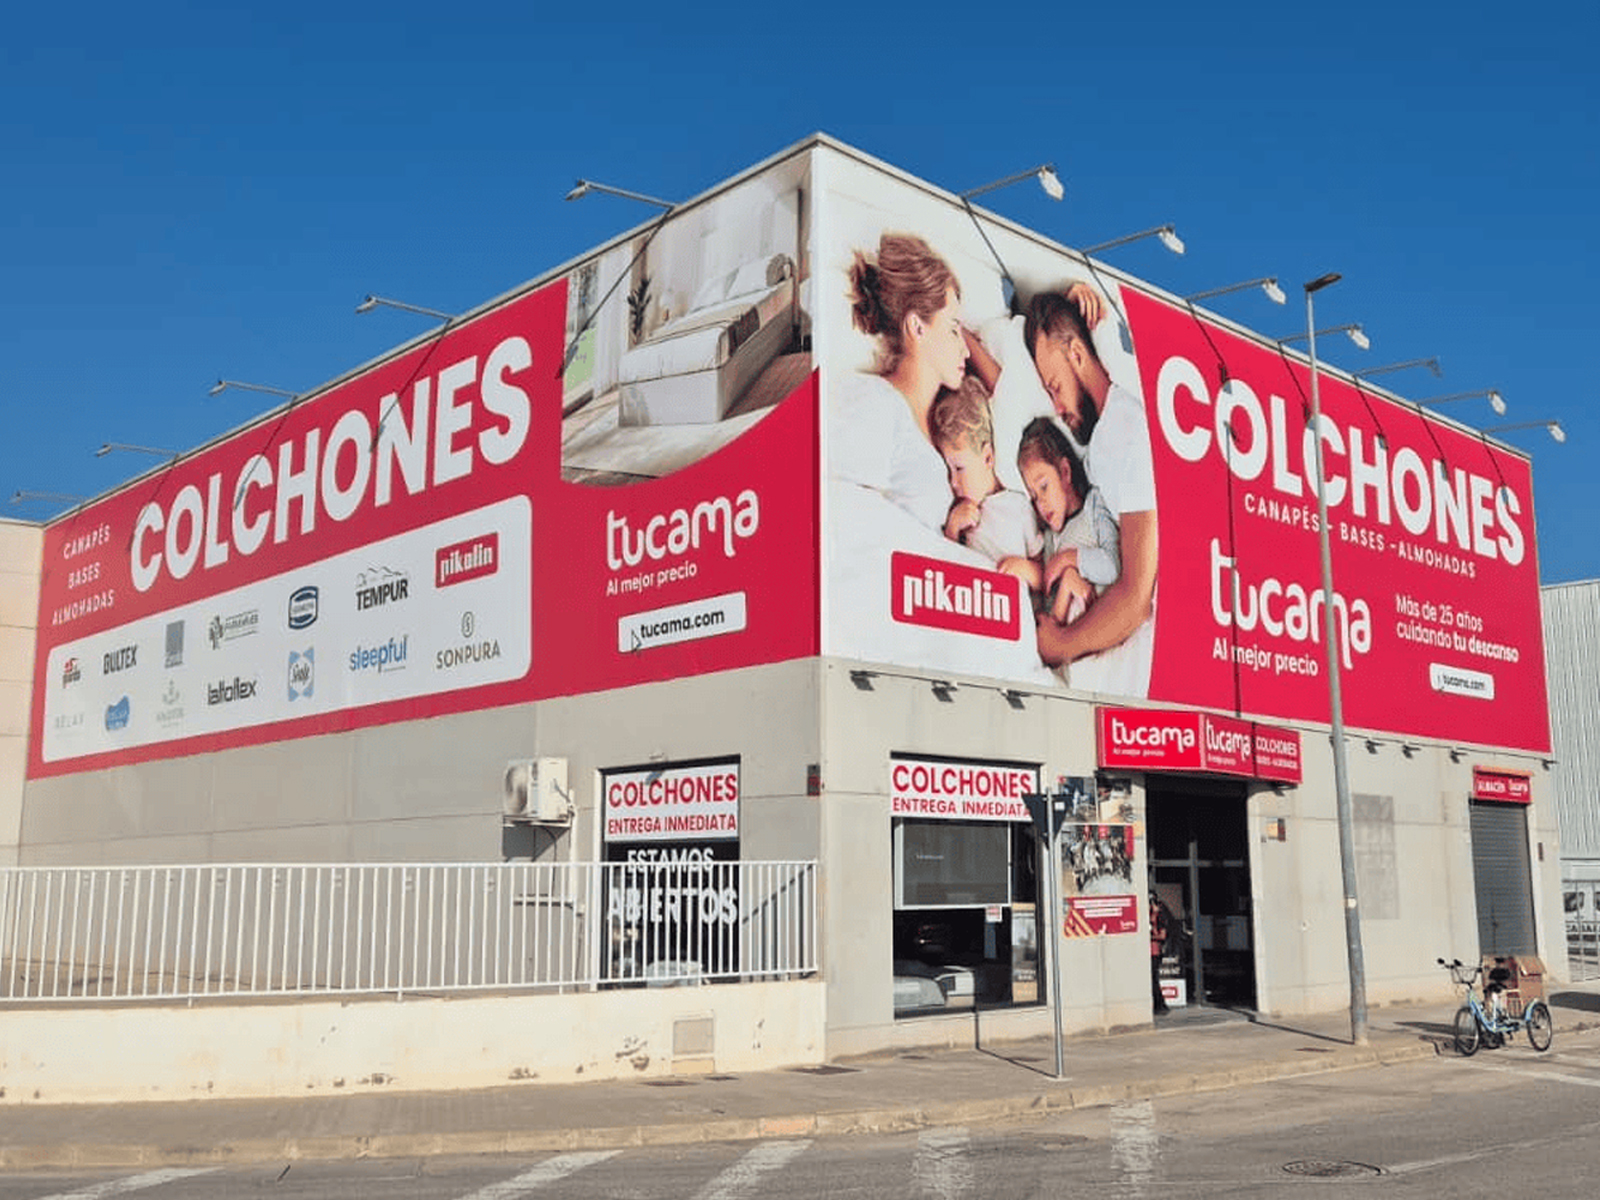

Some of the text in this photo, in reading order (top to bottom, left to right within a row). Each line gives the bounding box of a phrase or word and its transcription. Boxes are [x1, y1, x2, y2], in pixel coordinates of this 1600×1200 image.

[131, 336, 532, 592] COLCHONES
[1156, 355, 1525, 566] COLCHONES
[606, 489, 760, 570] tucama
[1244, 493, 1320, 532] CANAPÉS
[1340, 522, 1385, 552] BASES
[63, 523, 110, 560] CANAPÉS
[68, 561, 100, 589] BASES
[440, 543, 494, 582] pikolin
[605, 560, 698, 596] Al mejor precio
[356, 578, 409, 612] TEMPUR
[903, 569, 1011, 624] pikolin
[1210, 537, 1372, 670] tucama
[1421, 601, 1437, 622] de
[1440, 603, 1454, 625] 25
[640, 609, 725, 639] tucama.com
[1396, 620, 1519, 663] cuidando tu descanso
[350, 635, 408, 673] sleepful
[436, 640, 501, 669] SONPURA
[1213, 637, 1318, 676] Al mejor precio
[1112, 717, 1195, 754] tucama
[1206, 717, 1251, 761] tucama
[608, 774, 738, 807] COLCHONES
[892, 765, 1032, 797] COLCHONES
[893, 797, 957, 814] ENTREGA
[608, 814, 736, 835] ENTREGA INMEDIATA
[627, 847, 715, 873] ESTAMOS
